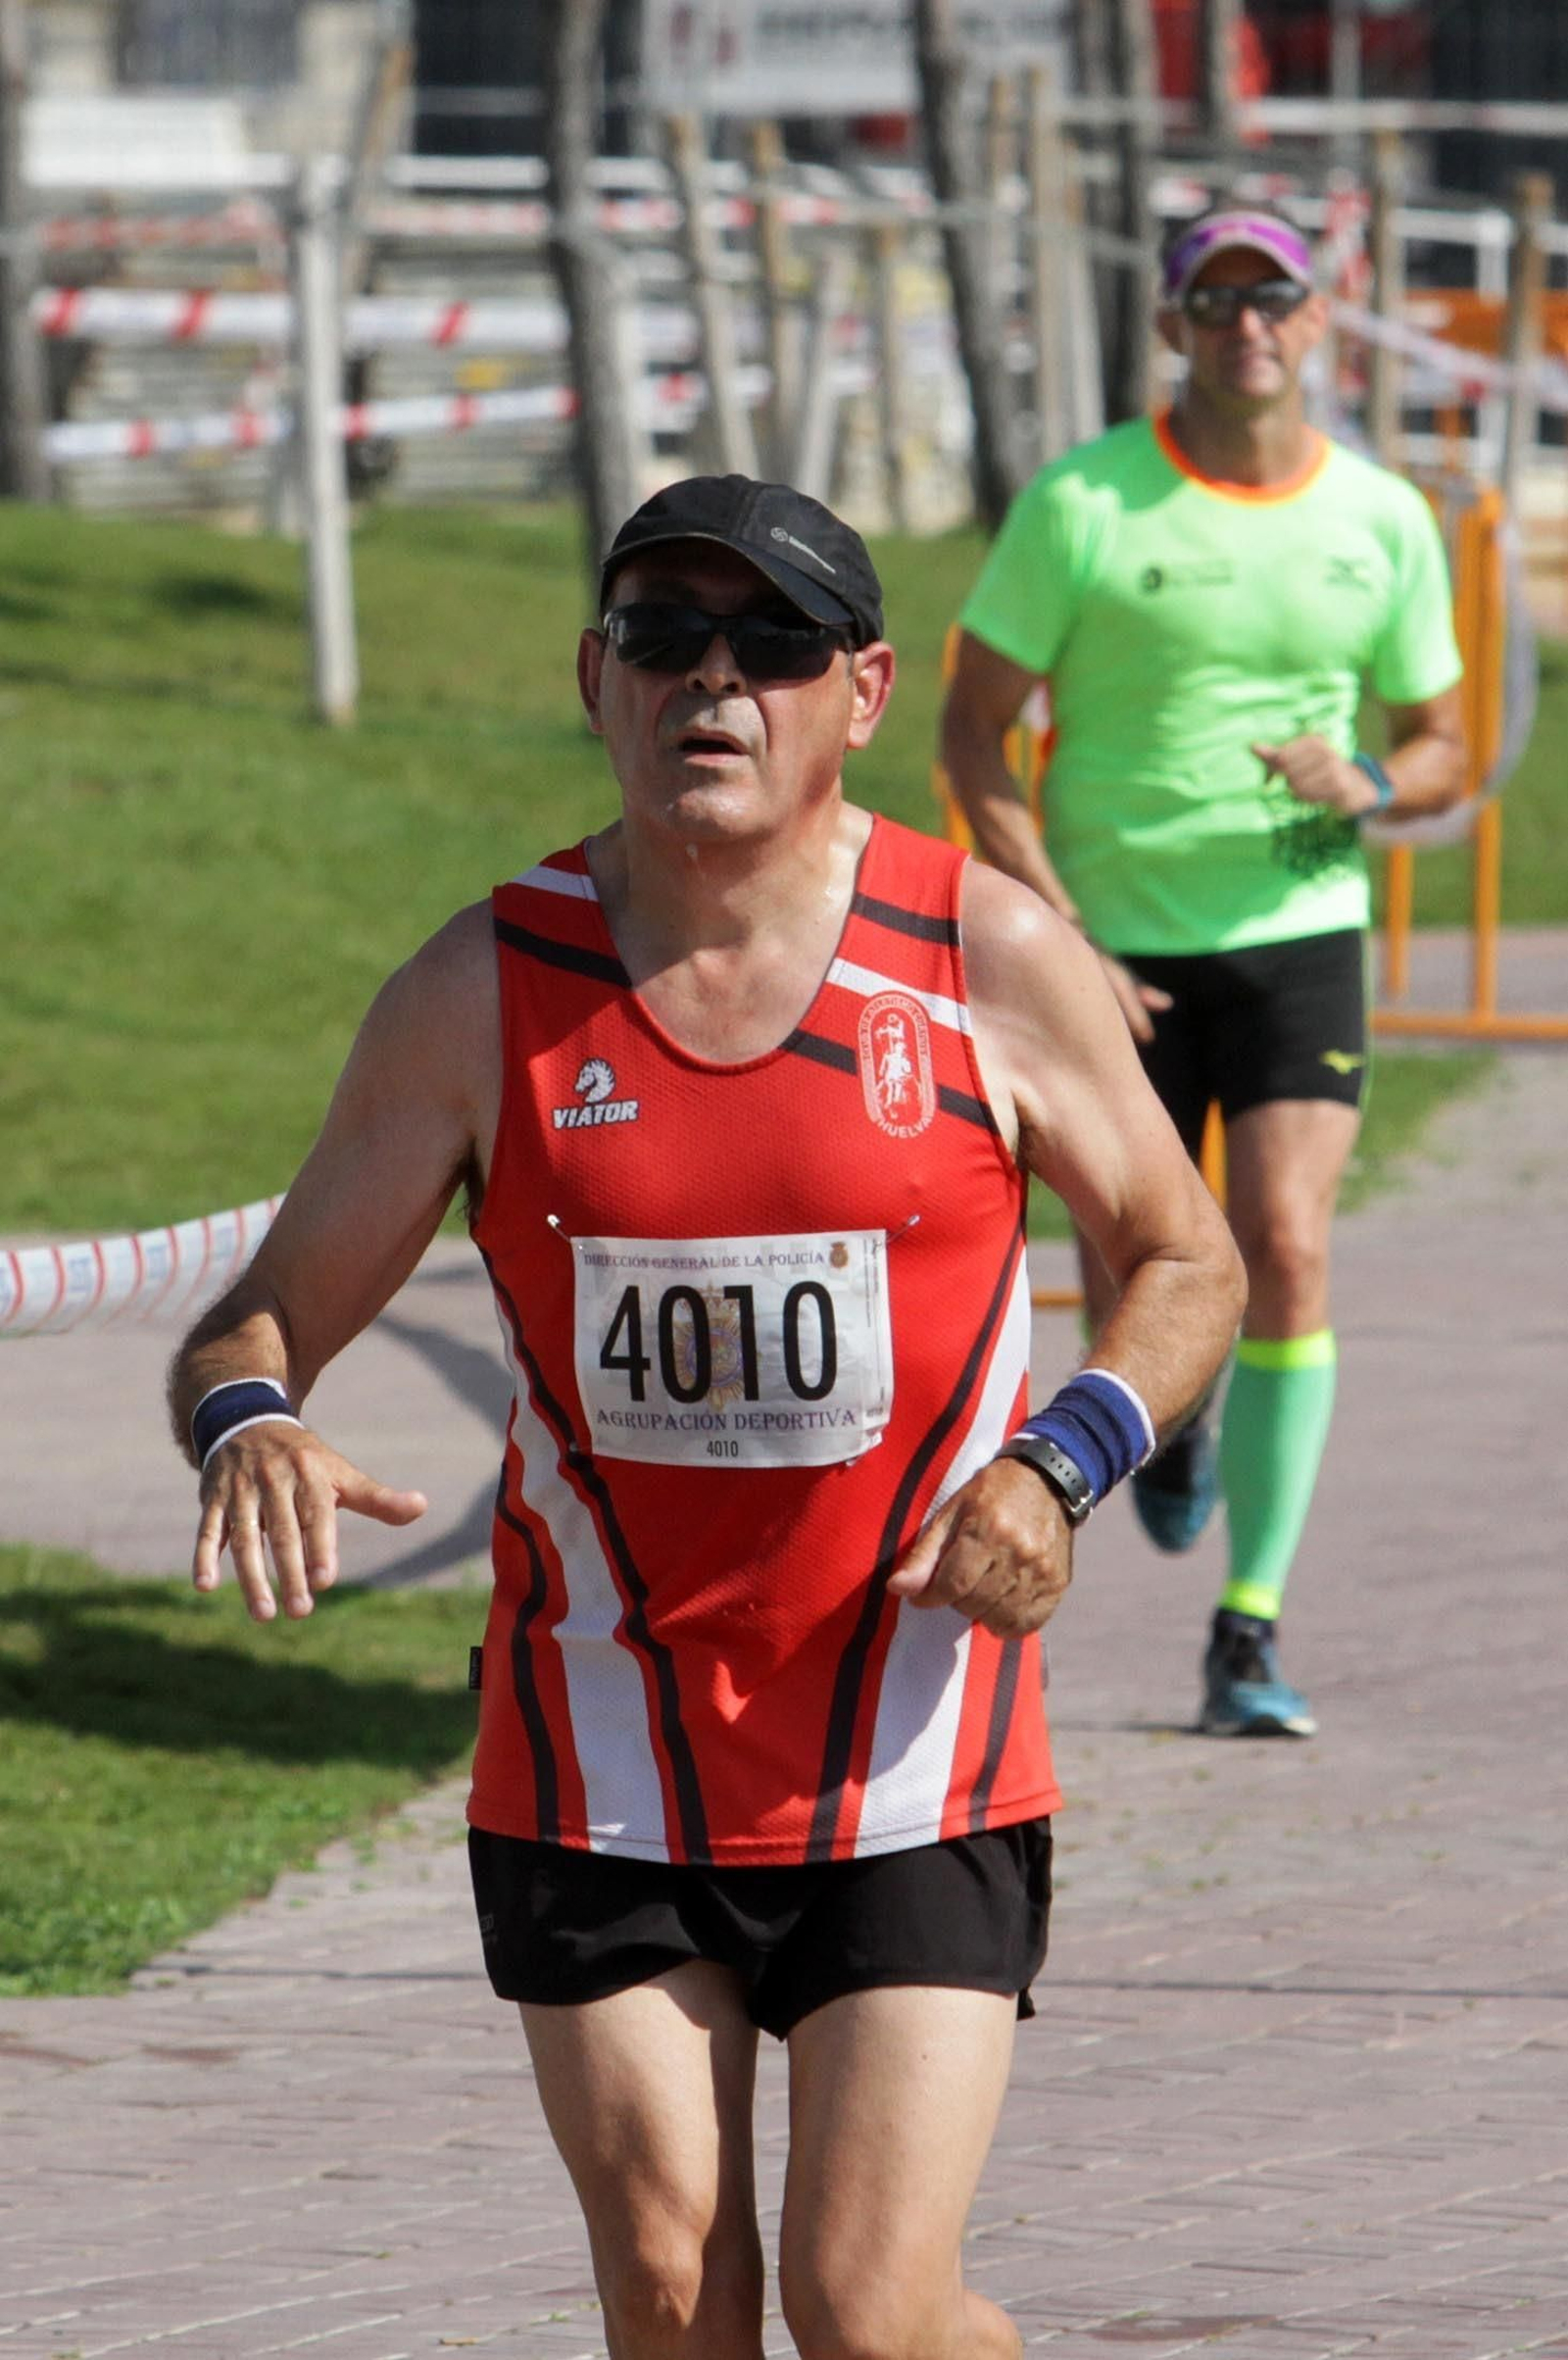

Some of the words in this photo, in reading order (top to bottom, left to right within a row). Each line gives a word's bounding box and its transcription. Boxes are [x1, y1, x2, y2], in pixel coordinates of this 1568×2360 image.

[553, 1099, 639, 1130] VIATOR
[651, 1255, 718, 1270] GENERAL
[721, 1255, 741, 1268] DE
[745, 1254, 764, 1267] LA
[768, 1251, 825, 1265] POLICÍA
[600, 1280, 837, 1403] 4010
[596, 1407, 727, 1431] AGRUPACIÓN
[735, 1407, 857, 1431] DEPORTIVA
[707, 1440, 739, 1457] 4010
